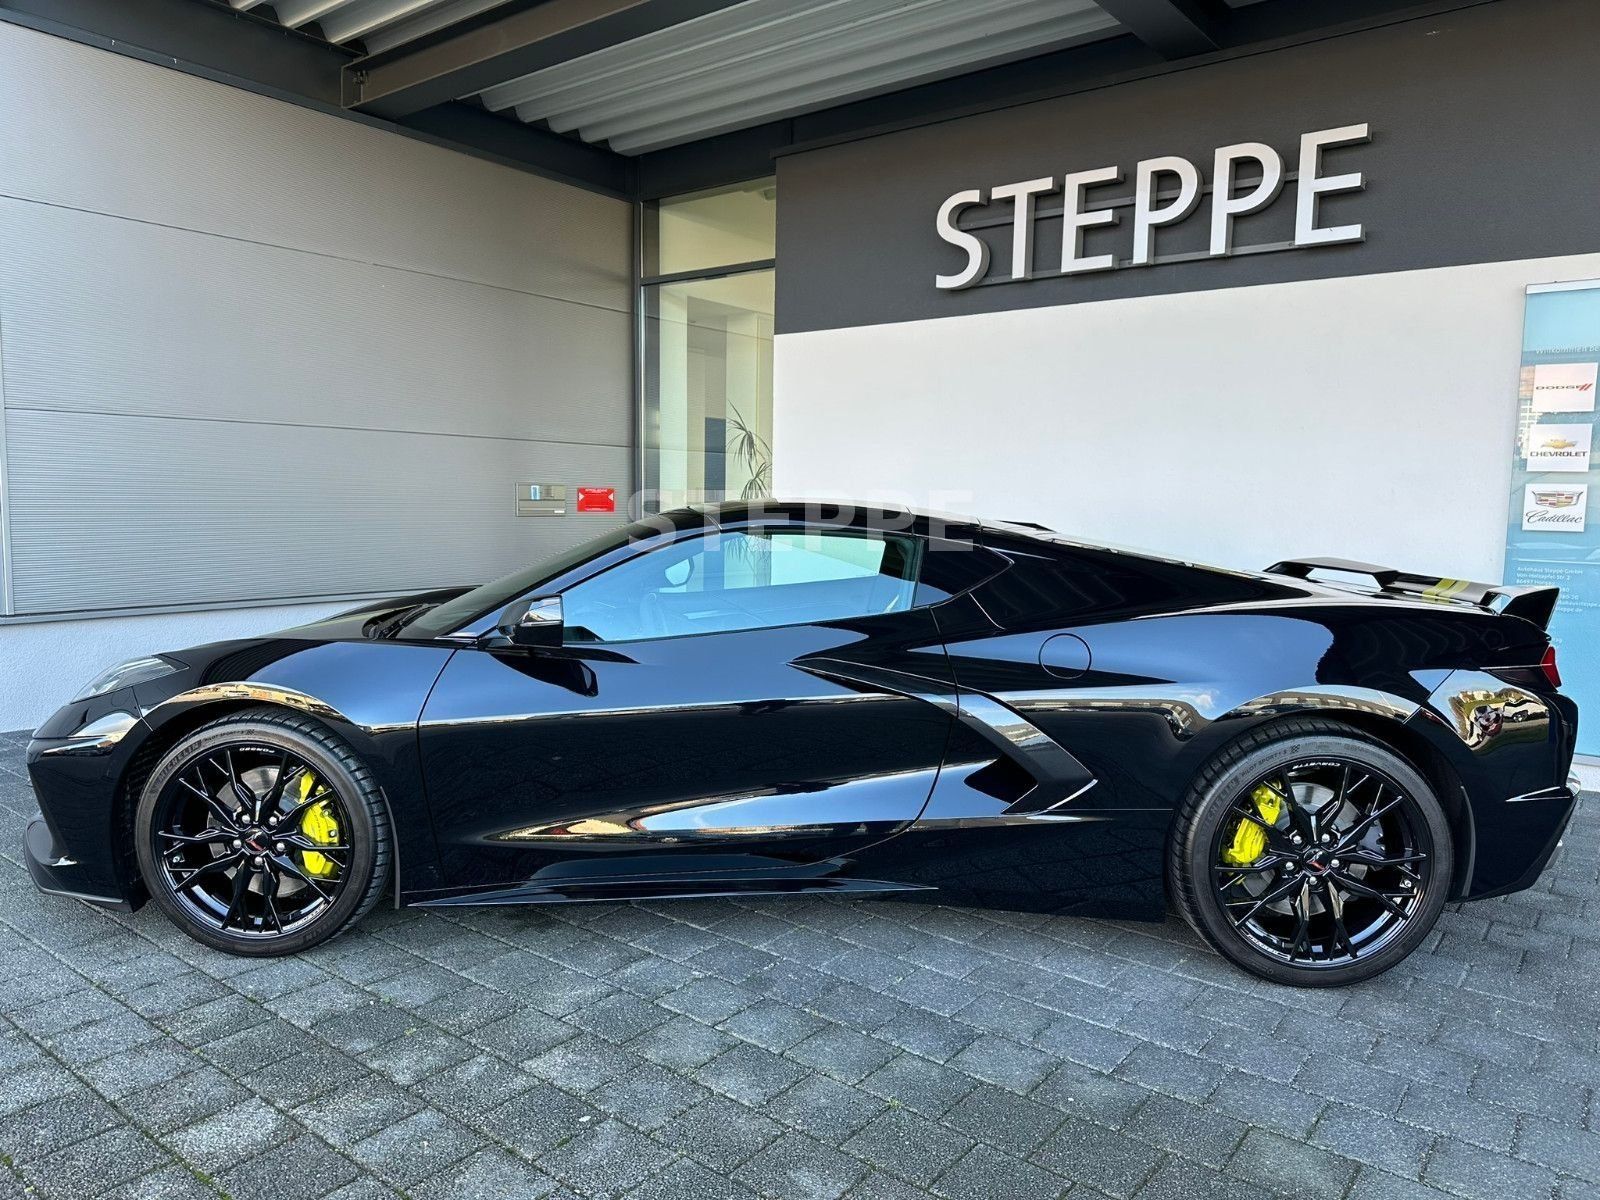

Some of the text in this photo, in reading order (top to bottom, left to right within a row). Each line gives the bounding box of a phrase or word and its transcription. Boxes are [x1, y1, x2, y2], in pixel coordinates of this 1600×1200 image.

[936, 123, 1370, 290] STEPPE
[1525, 510, 1582, 524] Cadillac
[157, 740, 202, 783] MICHELIN
